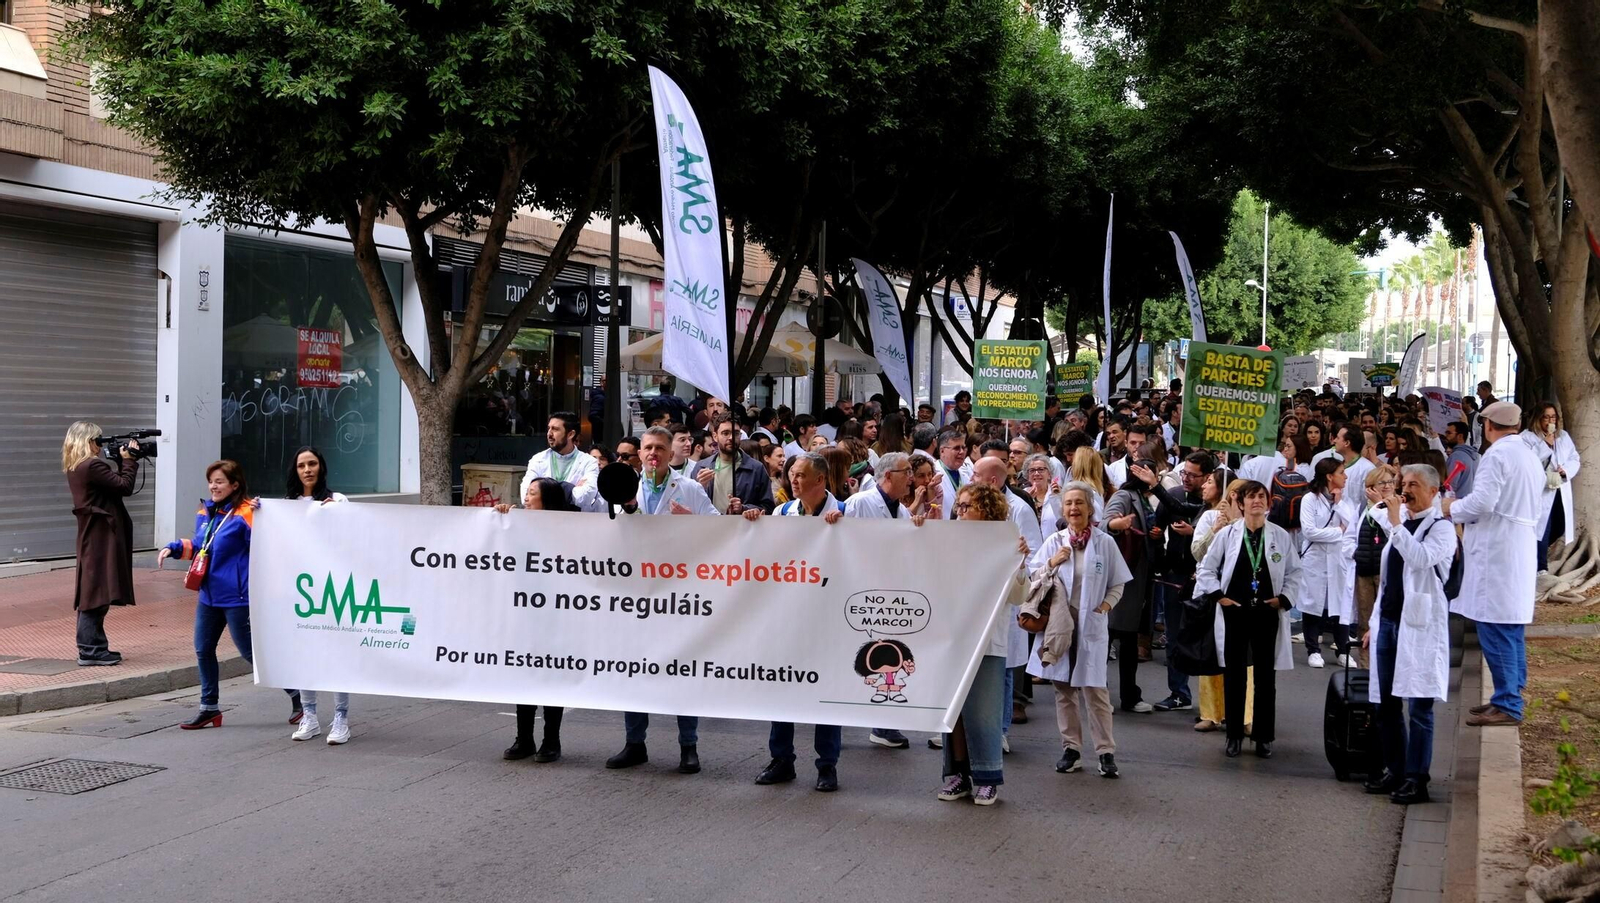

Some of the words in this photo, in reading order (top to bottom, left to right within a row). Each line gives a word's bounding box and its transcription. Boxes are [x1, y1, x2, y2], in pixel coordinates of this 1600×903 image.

[300, 330, 309, 341] SE
[311, 331, 340, 344] ALQUILA
[309, 343, 330, 355] LOCAL
[981, 346, 991, 354] EL
[994, 346, 1040, 356] ESTATUTO
[990, 356, 1032, 368] MARCO
[1206, 352, 1250, 370] BASTA
[1254, 359, 1272, 373] DE
[979, 368, 999, 378] NOS
[1001, 369, 1038, 379] IGNORA
[1201, 367, 1265, 387] PARCHES
[989, 384, 1027, 392] QUEREMOS
[977, 392, 1039, 402] RECONOCIMIENTO,
[1195, 385, 1258, 401] QUEREMOS
[1260, 393, 1276, 405] UN
[989, 400, 1037, 408] PRECARIEDAD
[1198, 398, 1265, 418] ESTATUTO
[1206, 412, 1257, 432] MÉDICO
[1206, 428, 1255, 446] PROPIO
[410, 547, 456, 569] Con
[465, 552, 516, 571] este
[526, 552, 633, 577] Estatuto
[641, 562, 688, 579] nos
[696, 558, 829, 587] explotáis,
[295, 570, 410, 627] SMA
[514, 591, 546, 608] no
[555, 593, 601, 611] nos
[609, 592, 713, 619] reguláis
[865, 596, 885, 604] NO
[892, 597, 909, 605] AL
[850, 606, 925, 616] ESTATUTO
[861, 617, 913, 627] MARCO!
[360, 636, 409, 649] Almería
[436, 646, 468, 663] Por
[474, 652, 498, 665] un
[504, 650, 587, 671] Estatuto
[594, 658, 660, 677] propio
[666, 659, 697, 677] del
[703, 662, 819, 684] Facultativo
